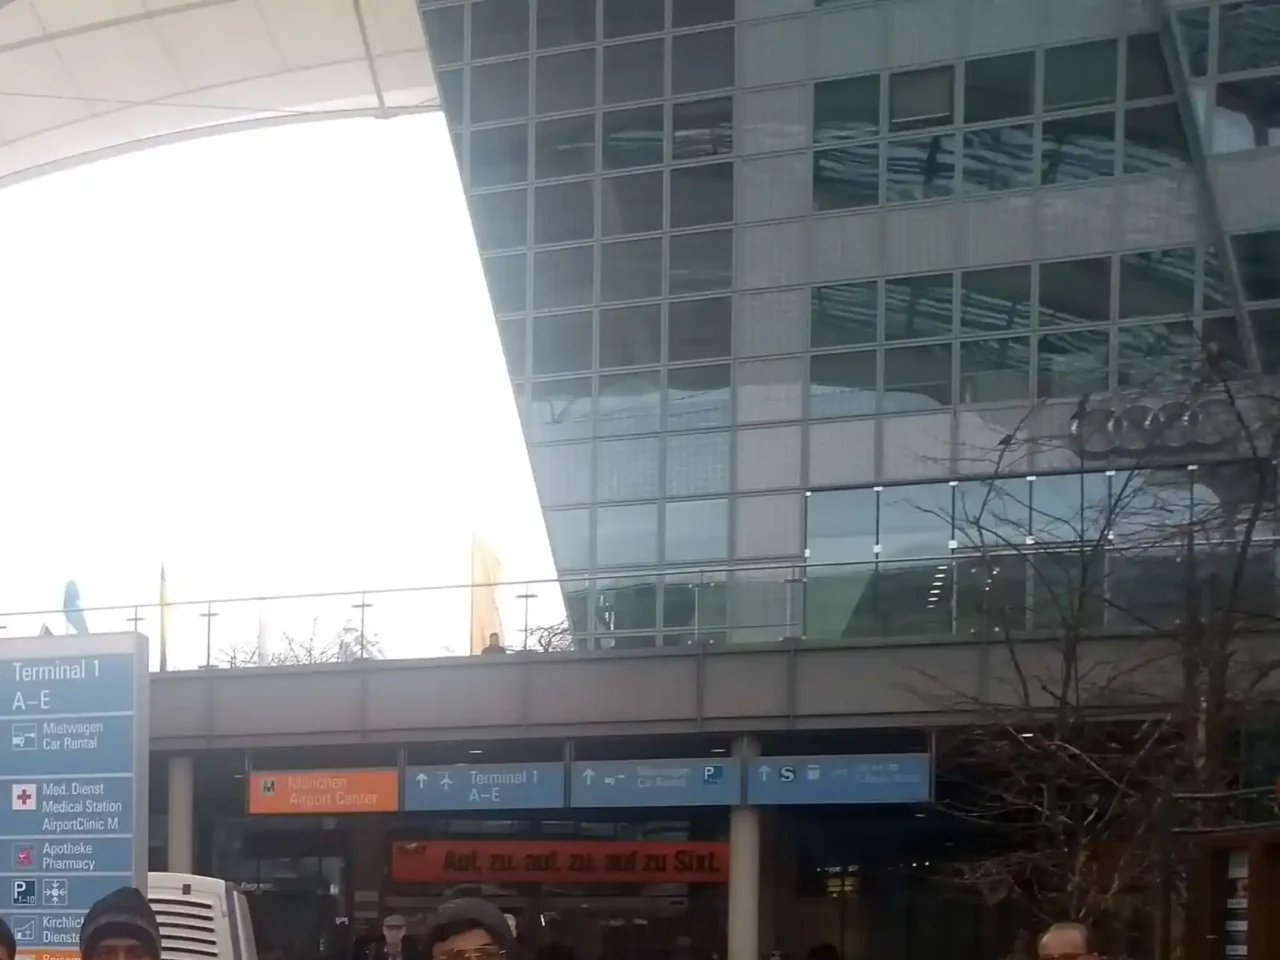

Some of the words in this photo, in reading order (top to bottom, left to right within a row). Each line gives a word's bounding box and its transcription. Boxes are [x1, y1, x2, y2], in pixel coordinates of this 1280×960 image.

[12, 660, 86, 681] Terminal
[93, 660, 100, 678] 1
[43, 722, 103, 736] Mietwagen
[43, 738, 61, 750] Car
[64, 737, 98, 749] Rental
[469, 770, 526, 786] Terminal
[532, 770, 539, 784] 1
[42, 783, 69, 796] Med.
[72, 783, 104, 795] Dienst
[289, 792, 332, 807] Airport
[335, 791, 378, 806] Center
[42, 801, 83, 813] Medical
[86, 800, 122, 812] Station
[42, 818, 105, 832] AirportClinic
[107, 817, 119, 830] M
[42, 842, 93, 856] Apotheke
[42, 857, 96, 871] Pharmacy
[14, 881, 26, 899] P
